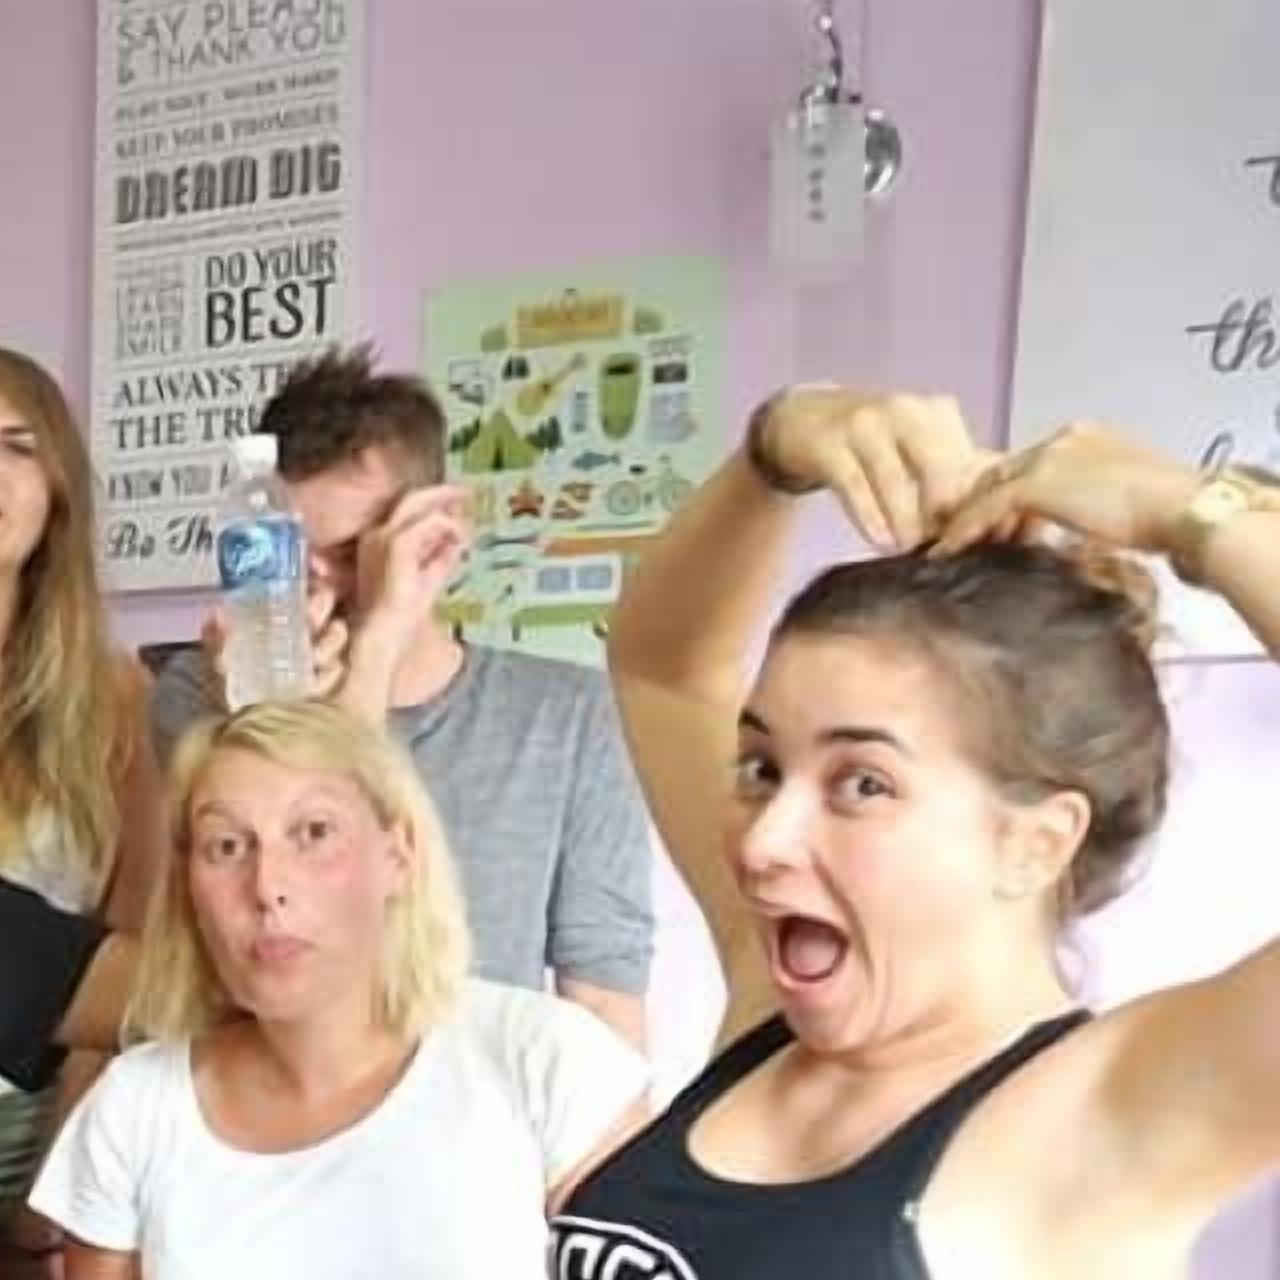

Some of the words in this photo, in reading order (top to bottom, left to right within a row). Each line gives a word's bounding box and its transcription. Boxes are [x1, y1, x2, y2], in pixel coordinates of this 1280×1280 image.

[116, 8, 189, 52] SAY
[148, 36, 253, 77] THANK
[267, 10, 346, 52] YOU
[116, 155, 257, 224] DREAM
[206, 252, 247, 288] DO
[251, 239, 337, 282] YOUR
[206, 274, 336, 348] BEST
[113, 364, 242, 409] ALWAYS
[107, 409, 188, 450] THE
